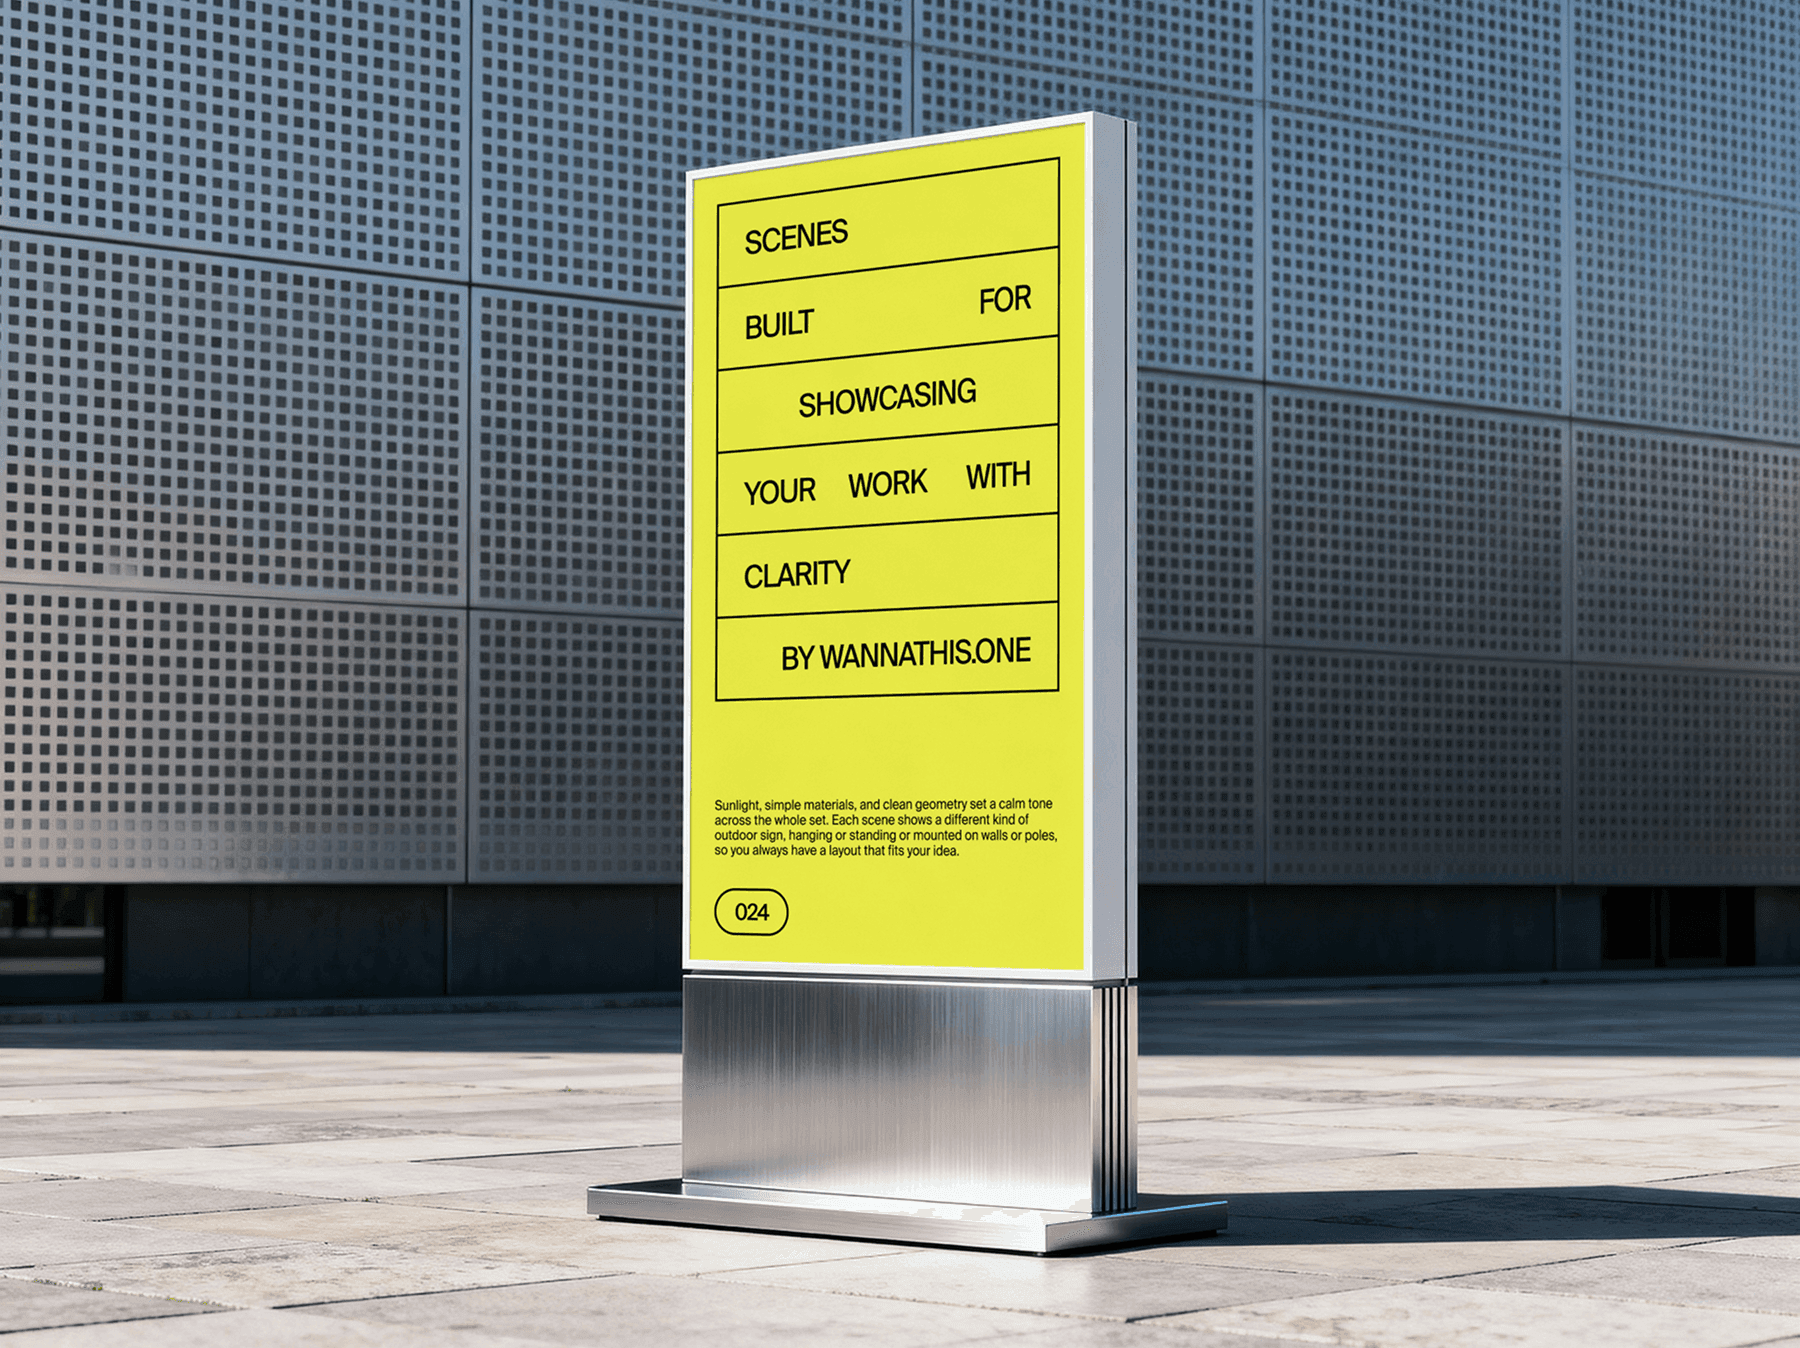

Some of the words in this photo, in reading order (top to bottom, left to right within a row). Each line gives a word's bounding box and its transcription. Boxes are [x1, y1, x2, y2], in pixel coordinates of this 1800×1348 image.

[745, 218, 848, 254] SCENES
[746, 308, 815, 339] BUILT
[981, 285, 1031, 314] FOR
[799, 378, 976, 418] SHOWCASING
[744, 477, 816, 505] YOUR
[848, 468, 928, 498] WORK
[966, 460, 1030, 489] WITH
[745, 559, 851, 589] CLARITY
[783, 645, 815, 670] BY
[820, 637, 1031, 669] WANNATHIS.ONE
[715, 800, 762, 813] Sunlight,
[765, 800, 801, 812] simple
[804, 799, 857, 811] materials,
[860, 799, 880, 810] and
[883, 799, 912, 810] clean
[915, 799, 967, 812] geometry
[970, 799, 986, 809] set
[989, 799, 997, 810] a
[999, 798, 1025, 809] calm
[1027, 799, 1053, 809] tone
[715, 817, 751, 825] across
[754, 815, 772, 825] the
[774, 815, 806, 825] whole
[809, 815, 828, 825] set.
[832, 814, 859, 825] Each
[862, 816, 895, 825] scene
[898, 814, 932, 825] shows
[934, 815, 942, 826] a
[944, 814, 990, 825] different
[993, 814, 1015, 825] kind
[1017, 812, 1030, 826] of
[714, 846, 729, 856] so
[731, 847, 749, 857] you
[752, 845, 788, 857] always
[791, 845, 817, 855] have
[819, 846, 827, 856] a
[829, 845, 861, 858] layout
[864, 845, 885, 856] that
[888, 845, 904, 856] fits
[907, 847, 930, 858] your
[934, 845, 959, 856] idea.
[715, 830, 757, 840] outdoor
[760, 830, 786, 843] sign,
[789, 830, 832, 843] hanging
[834, 831, 847, 841] or
[850, 830, 896, 843] standing
[898, 831, 911, 841] or
[914, 830, 962, 841] mounted
[964, 831, 979, 842] on
[981, 830, 1008, 841] walls
[1010, 831, 1023, 842] or
[1025, 830, 1057, 843] poles,
[735, 903, 770, 921] 024
